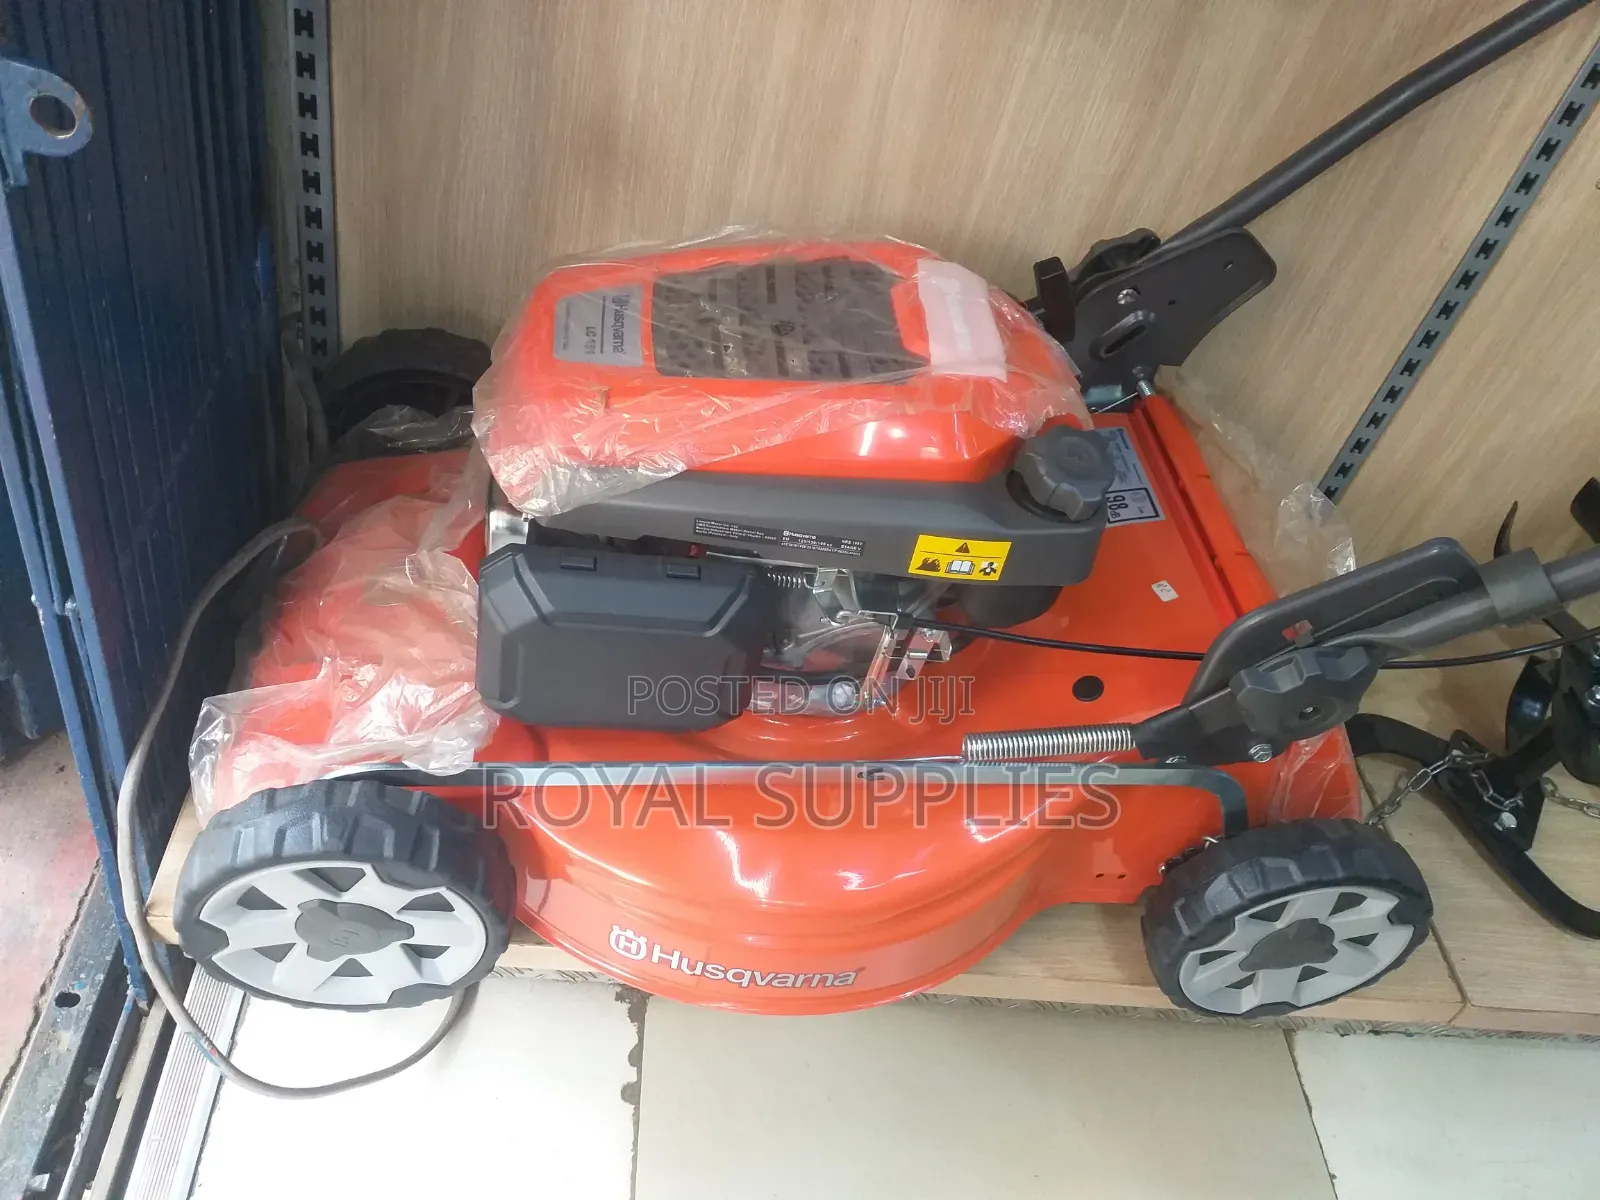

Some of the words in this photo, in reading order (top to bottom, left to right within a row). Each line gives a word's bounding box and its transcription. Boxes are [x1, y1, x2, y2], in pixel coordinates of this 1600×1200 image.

[585, 326, 596, 338] LC
[611, 303, 629, 354] Husqvarna
[1107, 495, 1128, 510] 98
[651, 943, 860, 988] Husqvarna
